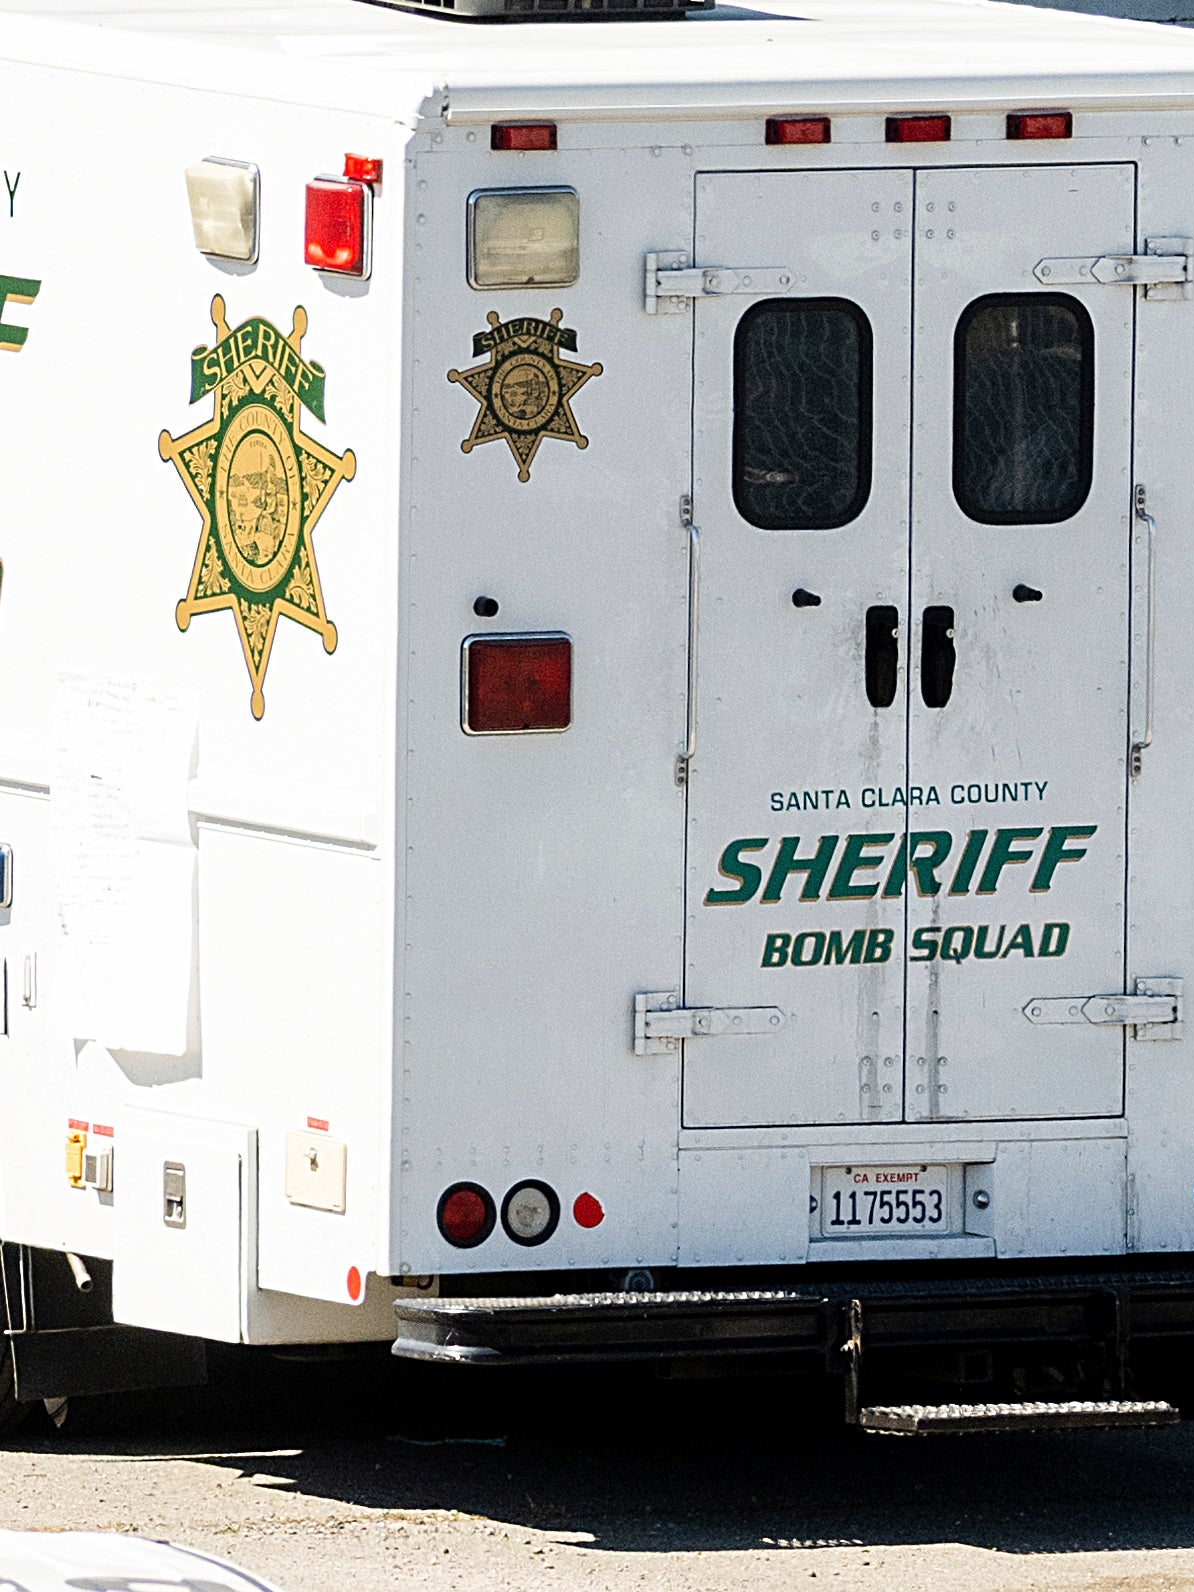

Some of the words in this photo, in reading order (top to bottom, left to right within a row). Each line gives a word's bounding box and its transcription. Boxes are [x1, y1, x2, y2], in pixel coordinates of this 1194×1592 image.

[481, 320, 568, 350] SHERIFF
[203, 324, 313, 391] SHERIFF
[239, 411, 285, 445] COUNTY
[770, 789, 852, 812] SANTA
[861, 785, 941, 808] CLARA
[950, 781, 1049, 805] COUNTY
[702, 824, 1099, 907] SHERIFF
[760, 927, 895, 969] BOMB
[909, 922, 1072, 965] SQUAD
[853, 1173, 869, 1184] CA
[875, 1172, 920, 1183] EXEMPT
[830, 1189, 943, 1226] 1175553
